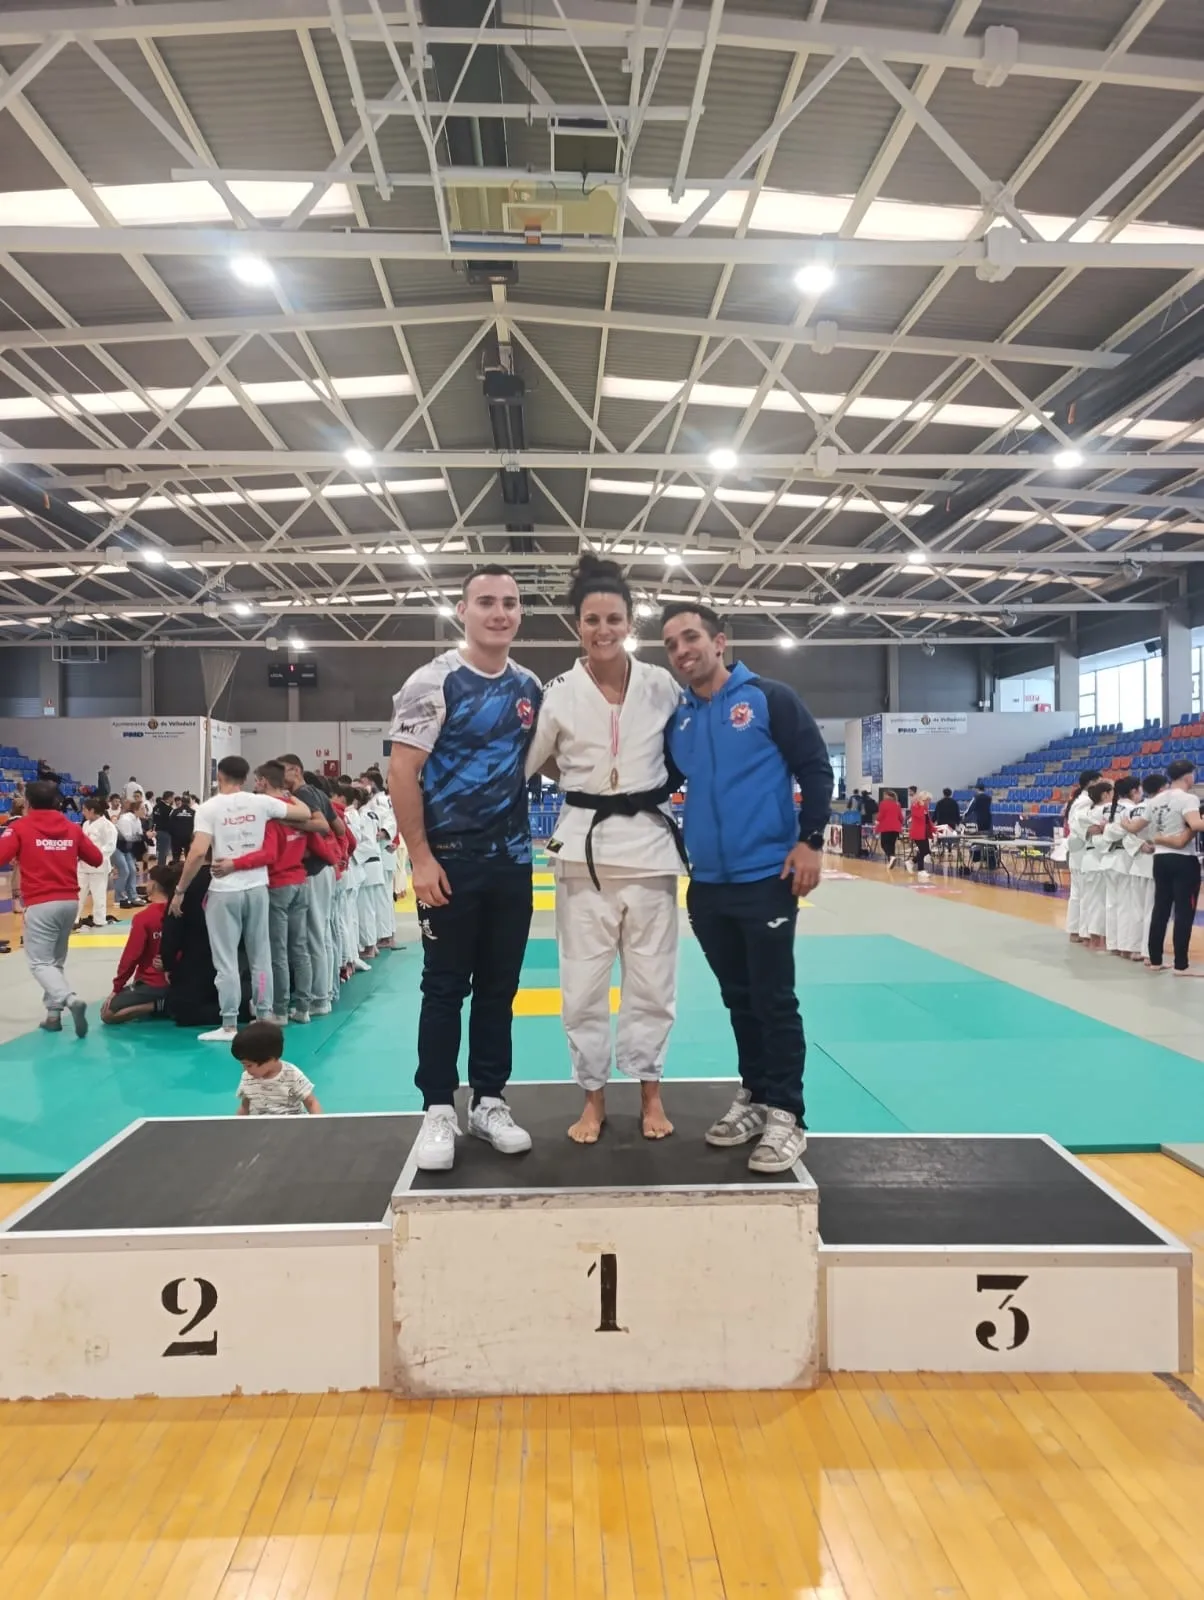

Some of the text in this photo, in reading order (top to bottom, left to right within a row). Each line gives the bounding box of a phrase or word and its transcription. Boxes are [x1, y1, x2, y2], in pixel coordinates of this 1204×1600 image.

[161, 1277, 218, 1357] 2
[587, 1253, 622, 1332] 1
[975, 1274, 1030, 1352] 3
